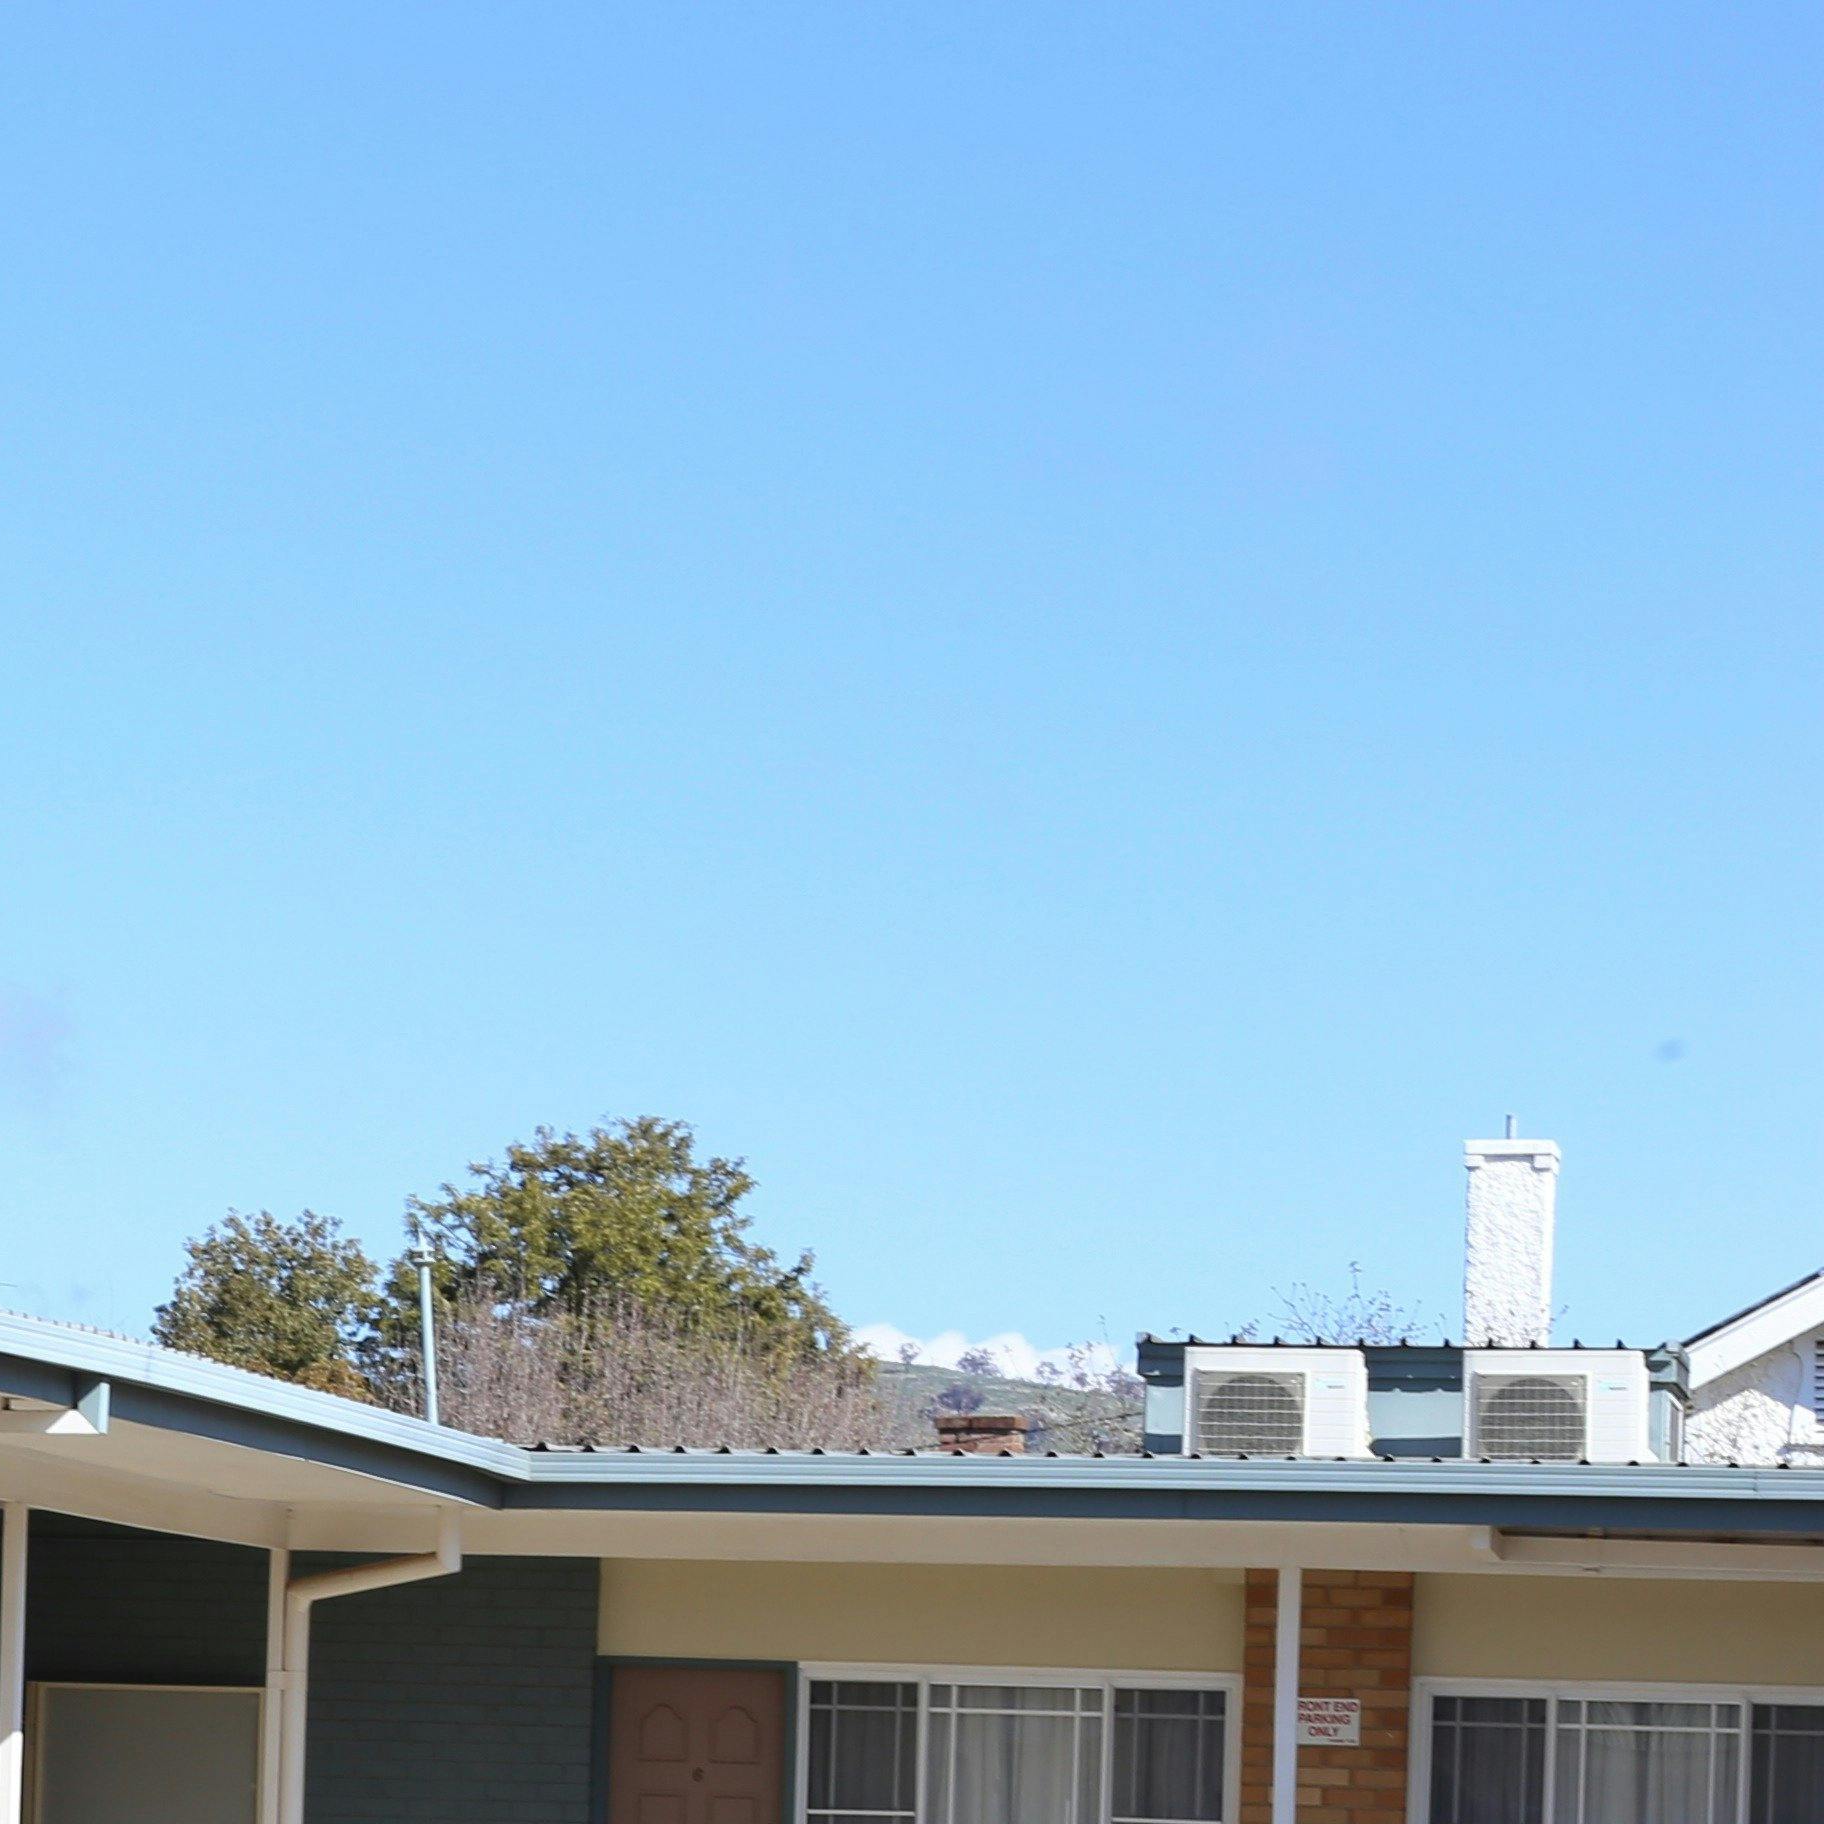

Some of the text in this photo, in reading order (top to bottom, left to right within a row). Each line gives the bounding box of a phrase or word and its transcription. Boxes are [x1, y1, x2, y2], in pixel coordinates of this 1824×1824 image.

[1298, 1701, 1359, 1712] RONT END
[1298, 1712, 1351, 1725] PARKING
[1308, 1726, 1339, 1737] ONLY
